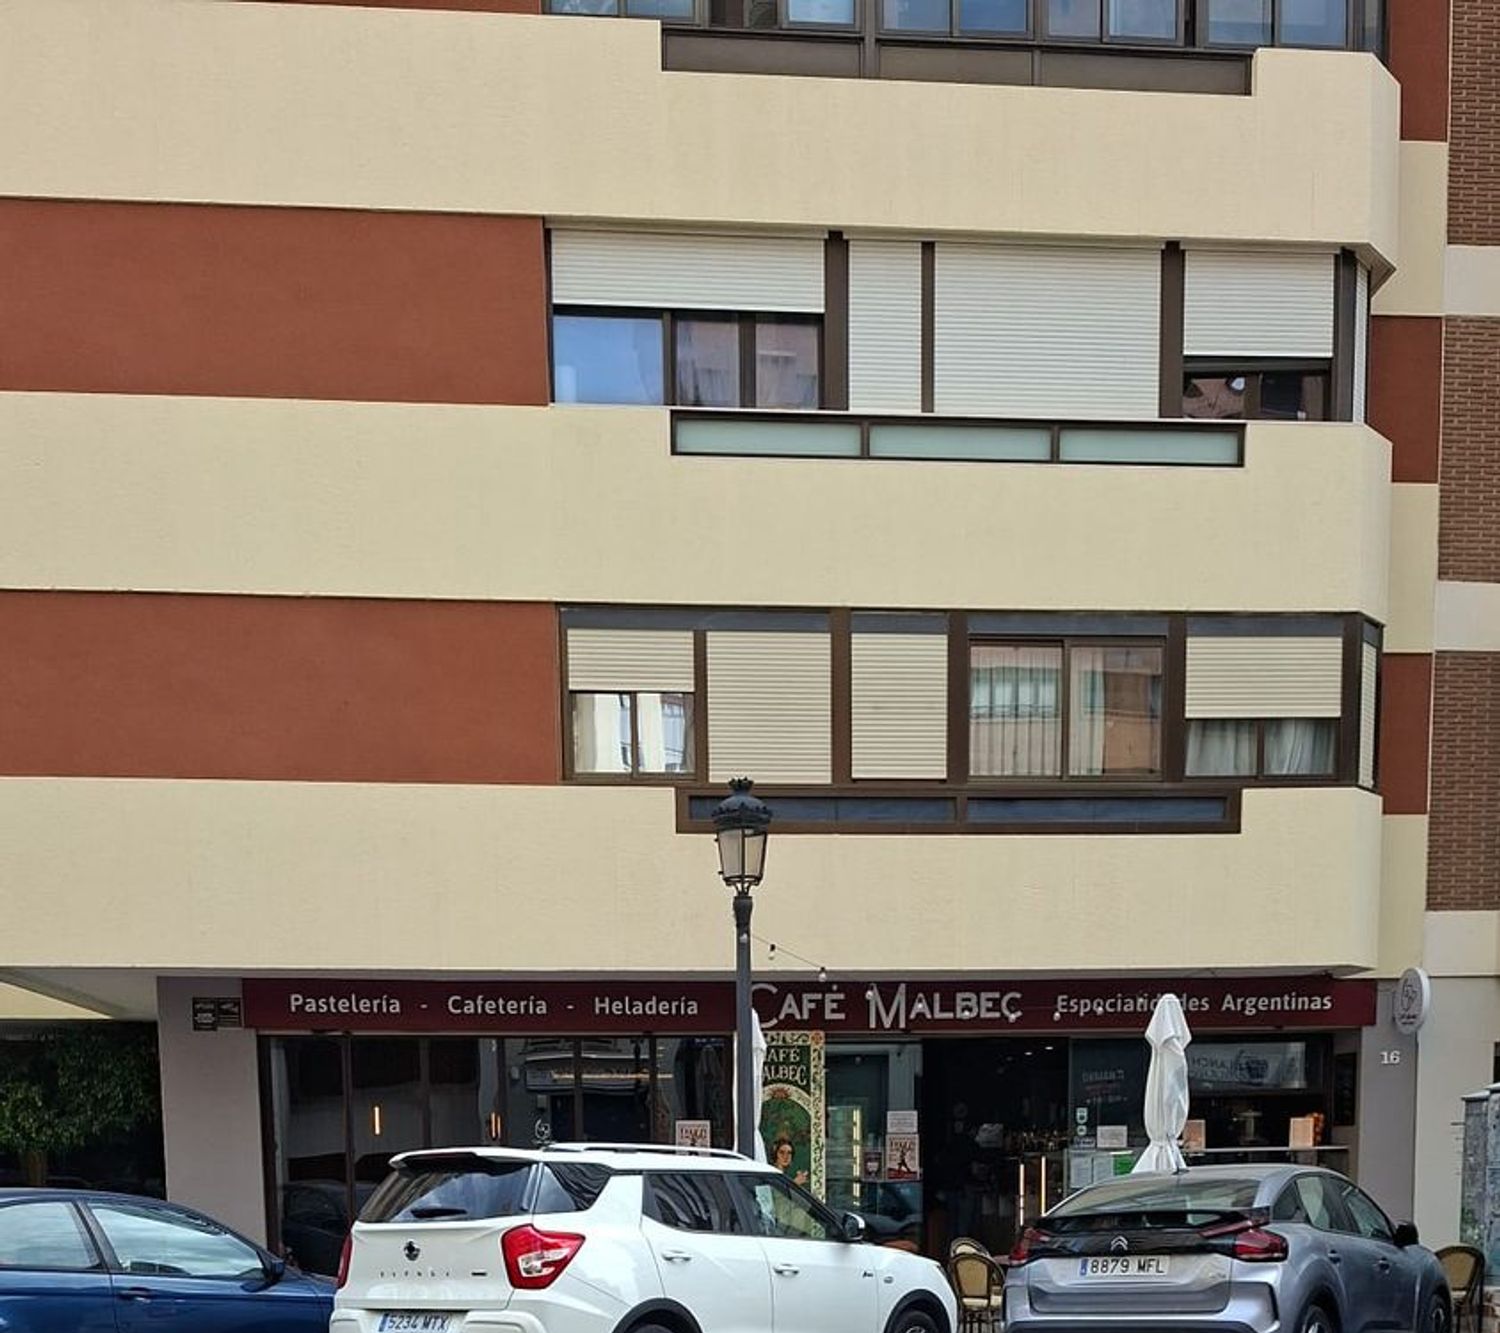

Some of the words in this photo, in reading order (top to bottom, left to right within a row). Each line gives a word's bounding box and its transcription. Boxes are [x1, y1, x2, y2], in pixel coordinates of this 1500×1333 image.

[289, 994, 400, 1014] Pastelería
[447, 995, 548, 1015] Cafetería
[594, 996, 699, 1016] Heladería
[868, 983, 1023, 1029] MALBEC
[1221, 992, 1332, 1016] Argentinas
[766, 1045, 801, 1063] AFÉ
[1380, 1051, 1400, 1065] 16
[762, 1064, 808, 1086] ALBEC
[1090, 1258, 1130, 1274] 8879
[1137, 1257, 1165, 1274] MFL
[387, 1314, 418, 1330] 5234
[420, 1315, 449, 1331] MTX
